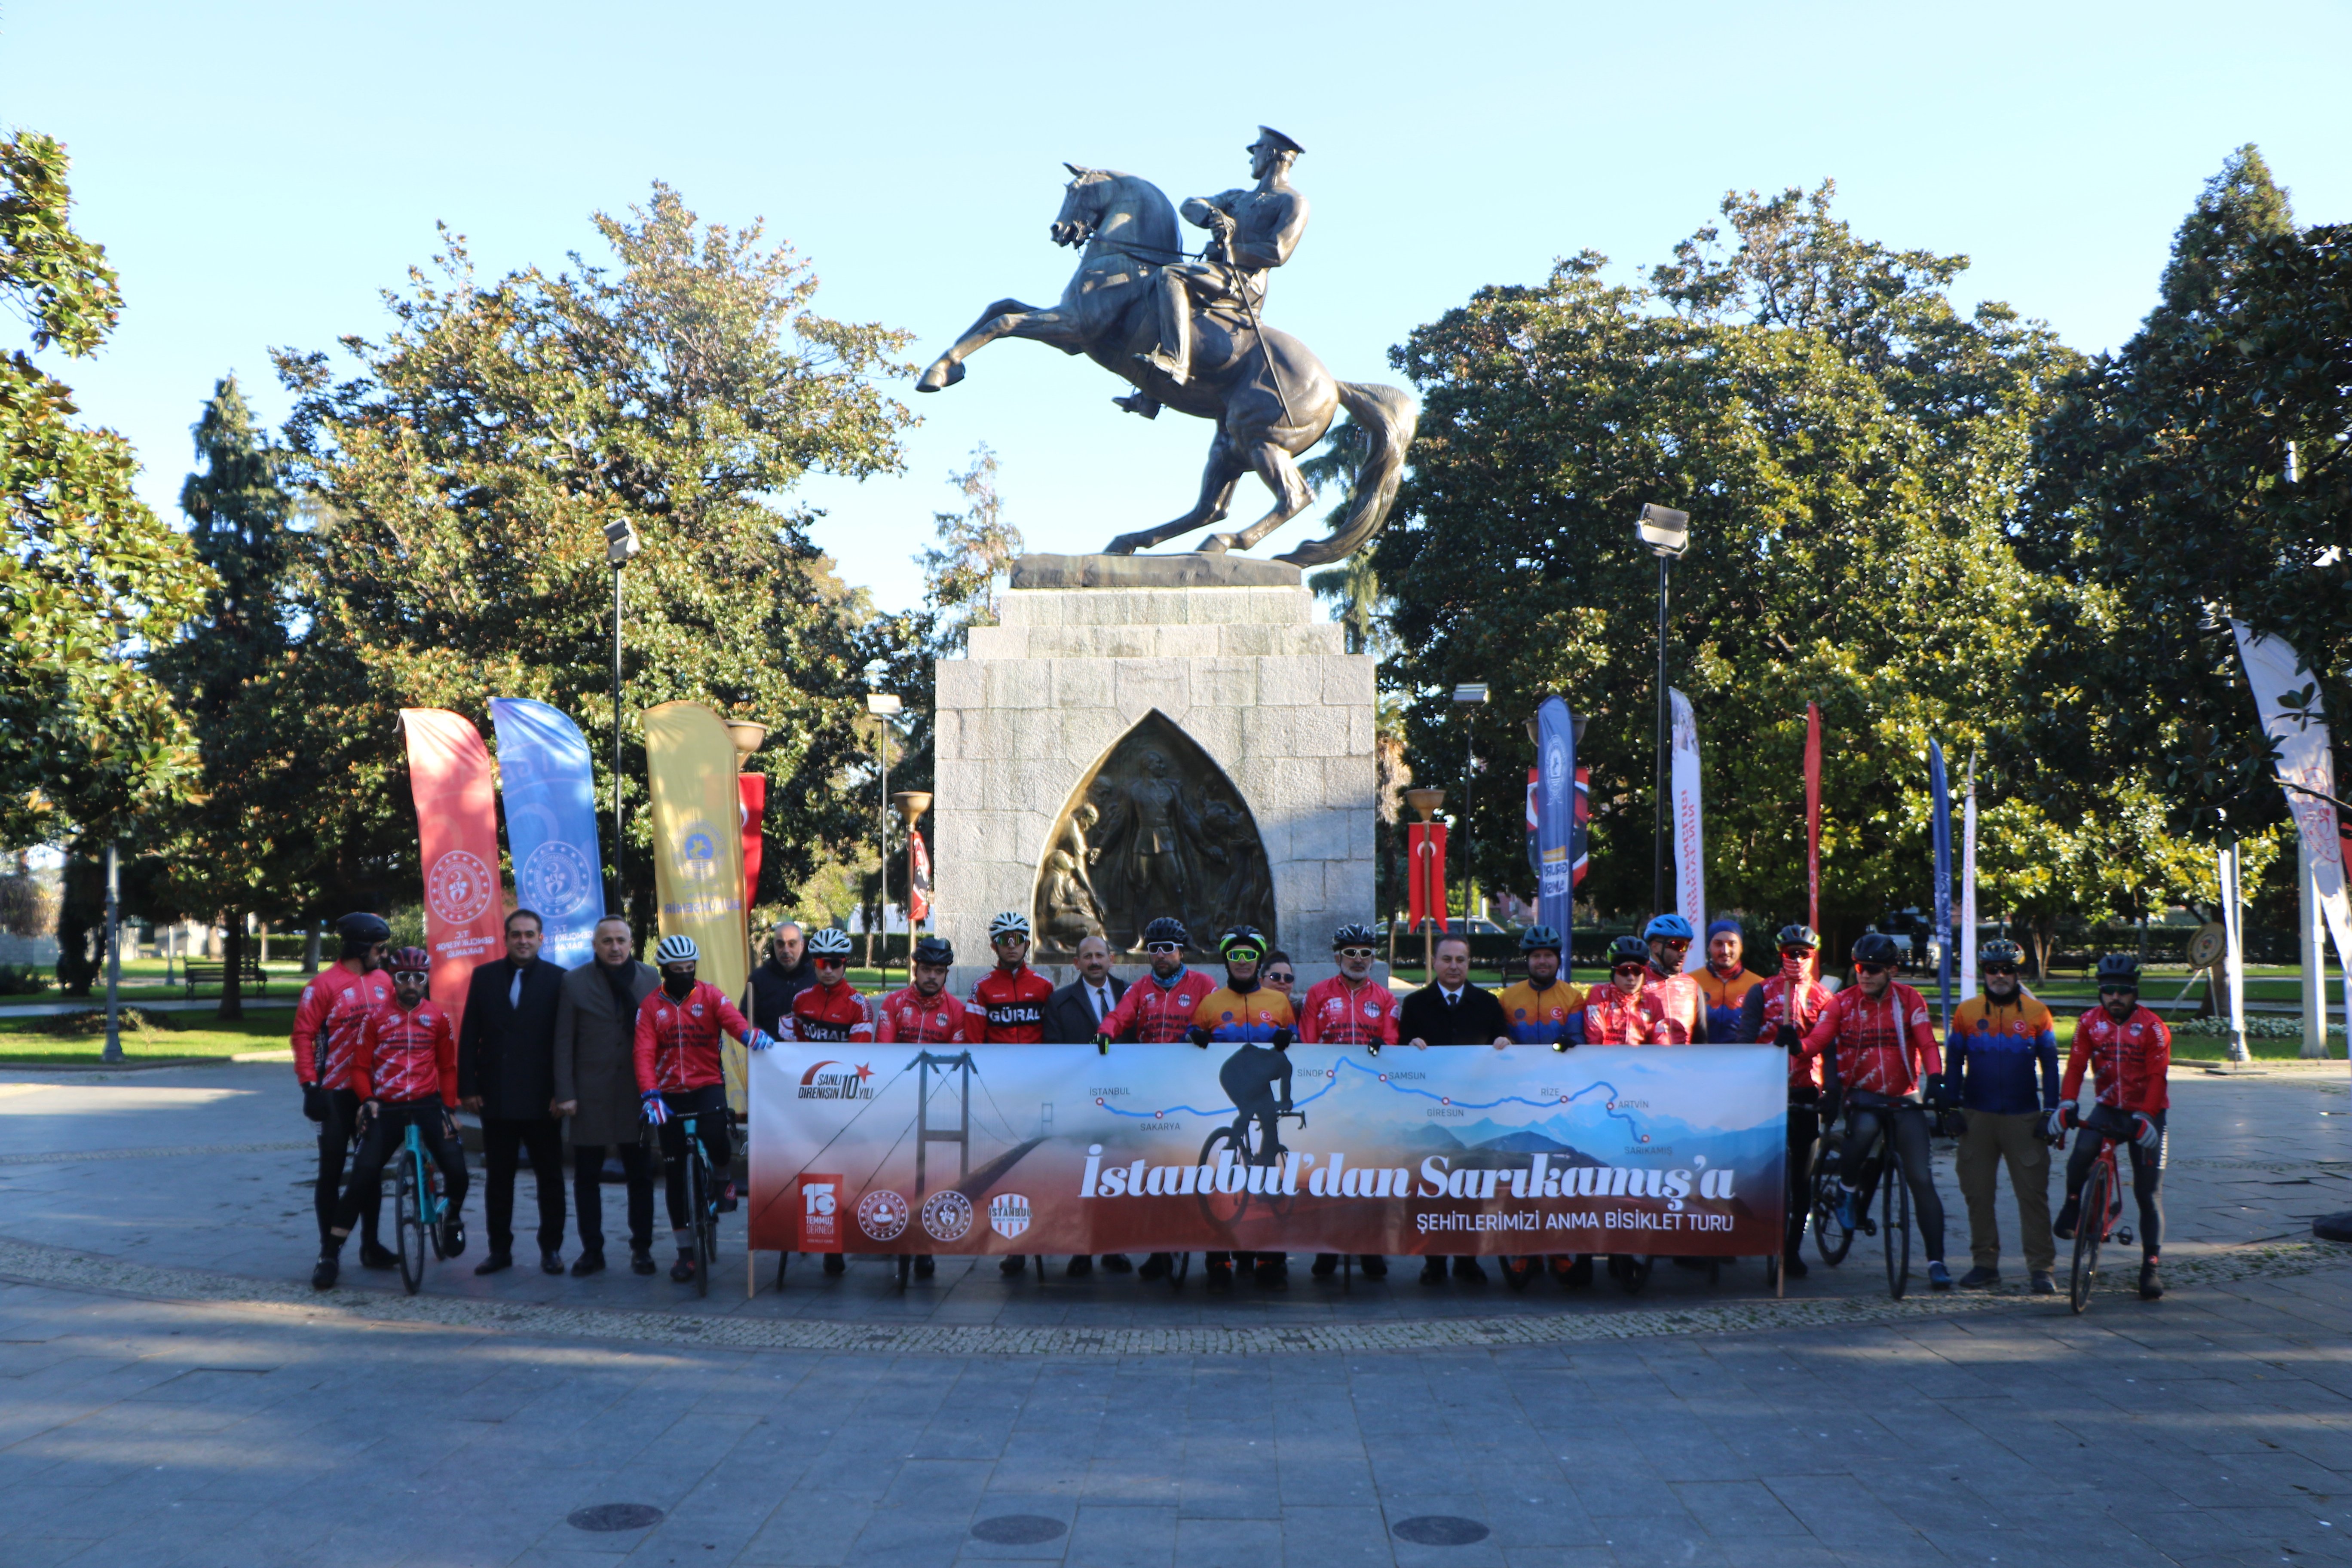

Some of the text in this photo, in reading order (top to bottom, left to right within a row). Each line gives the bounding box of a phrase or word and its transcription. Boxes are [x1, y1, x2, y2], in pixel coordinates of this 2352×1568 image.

[989, 1007, 1041, 1022] GÜRAL
[802, 1022, 848, 1041] GÜRAL
[1298, 1069, 1323, 1077] SİNOP
[818, 1075, 842, 1086] ŞANLI
[1089, 1086, 1130, 1095] İSTANBUL
[1541, 1088, 1559, 1096] RİZE
[1618, 1100, 1649, 1109] ARTVİN
[1427, 1107, 1464, 1117] GİRESUN
[1140, 1122, 1181, 1131] SAKARYA
[1624, 1146, 1672, 1156] SARIKAMIŞ
[802, 1183, 837, 1216] 15
[988, 1204, 1032, 1218] İSTANBUL
[806, 1216, 834, 1225] TEMMUZ
[1416, 1210, 1734, 1234] ŞEHİTLERİMİZİ ANMA BİSİKLET TURU
